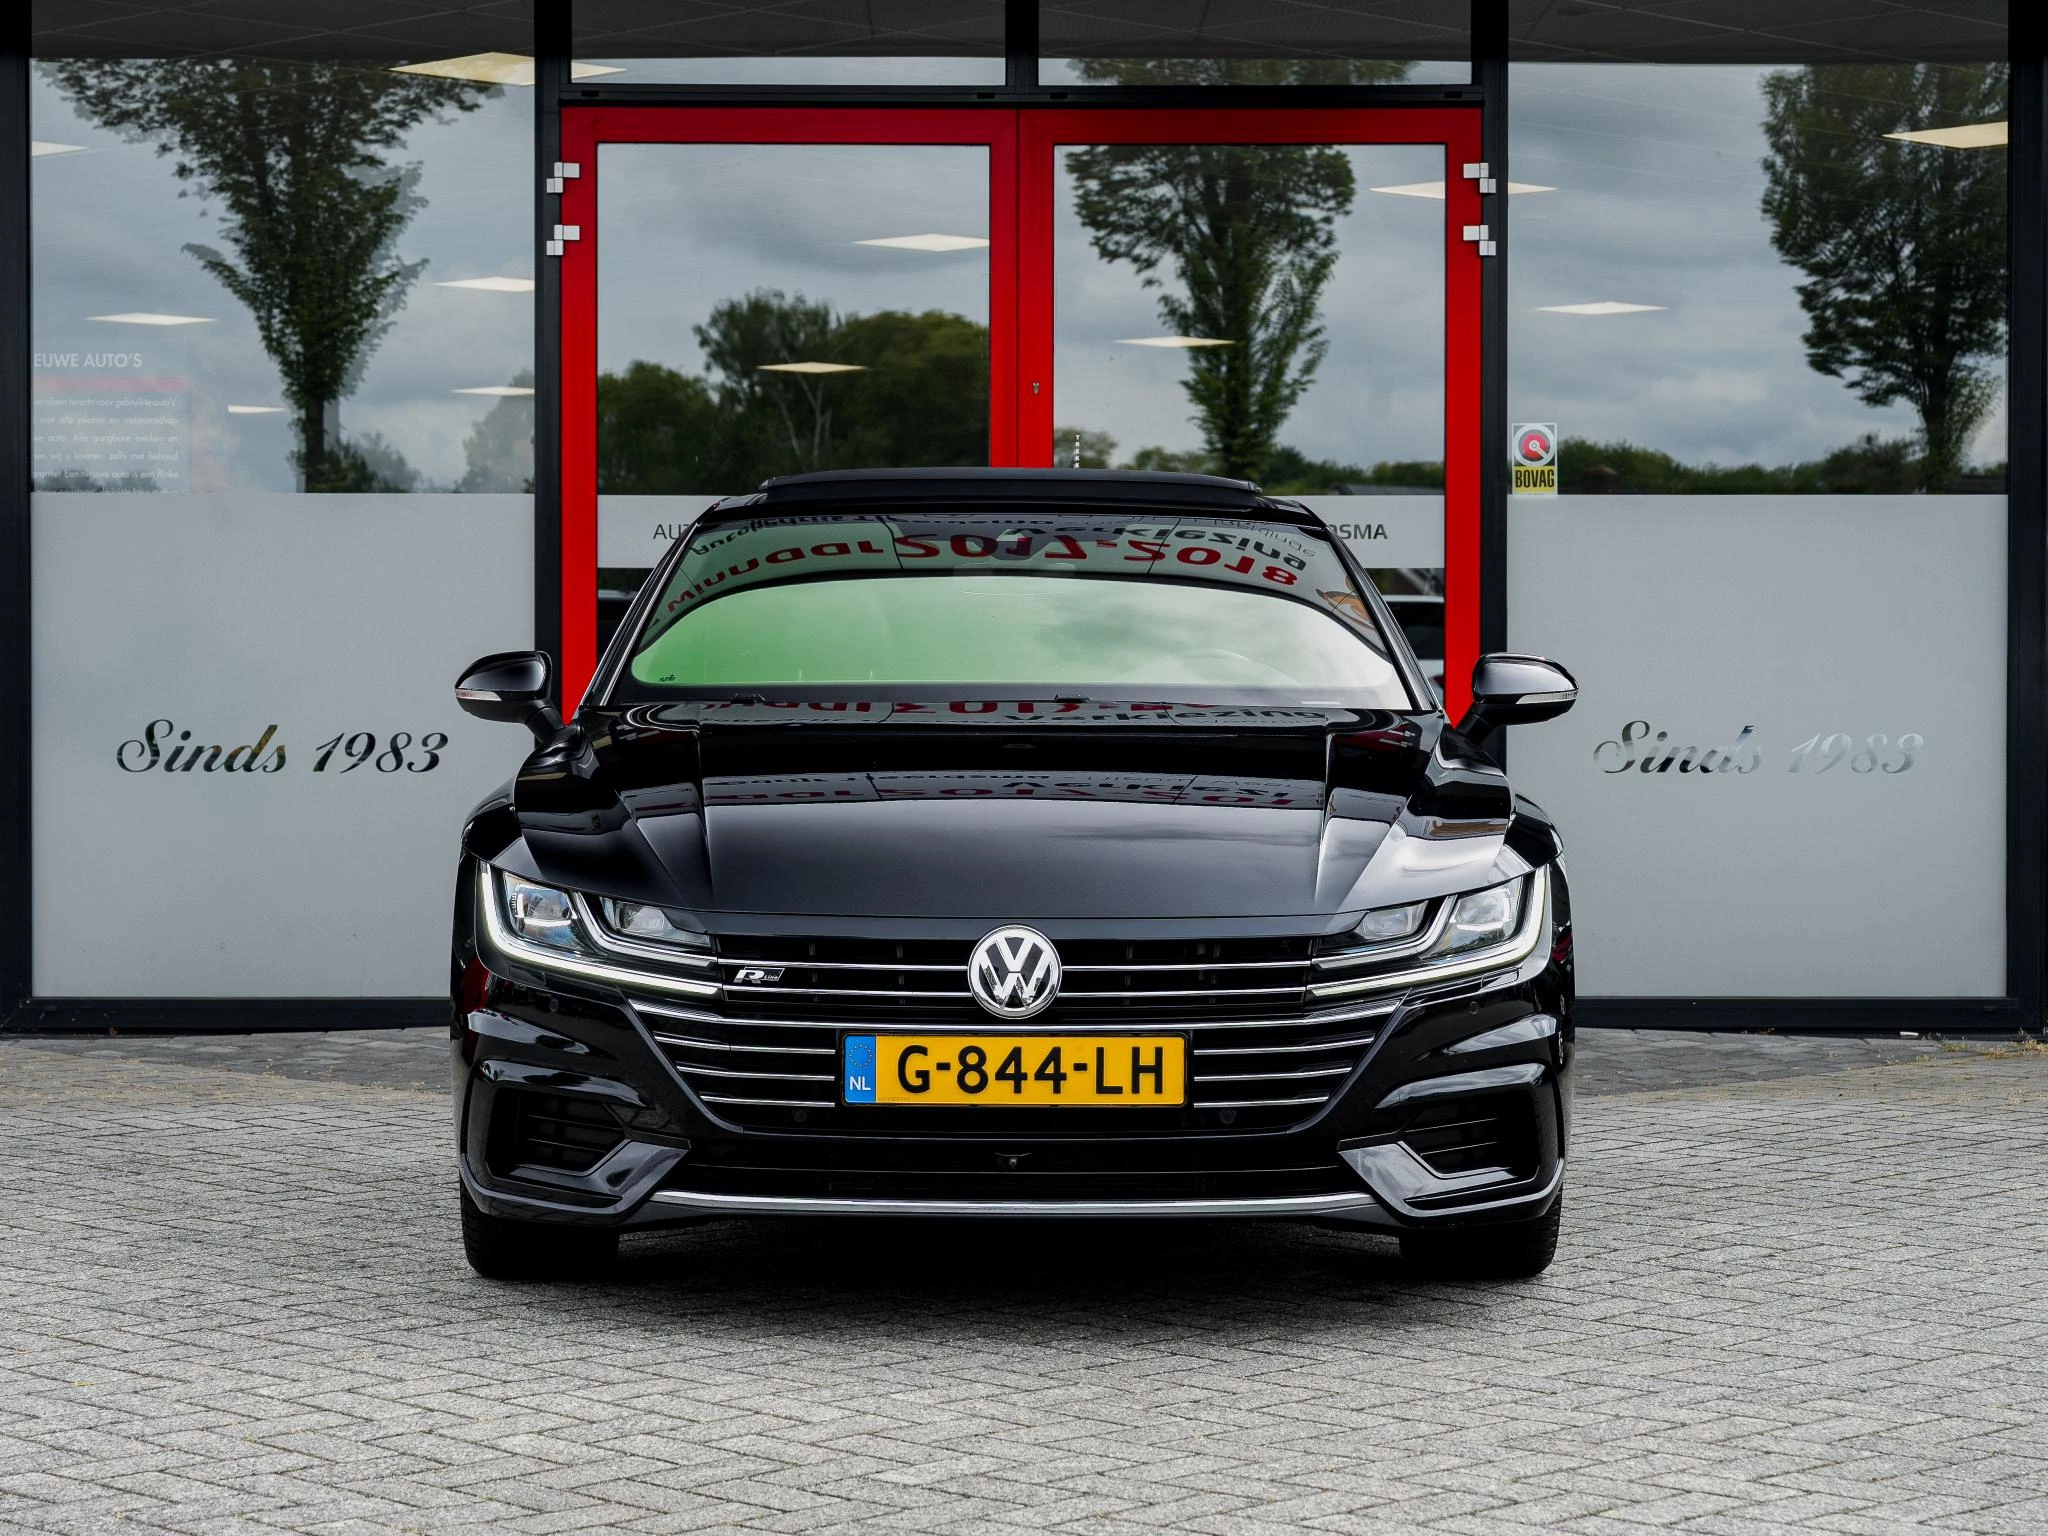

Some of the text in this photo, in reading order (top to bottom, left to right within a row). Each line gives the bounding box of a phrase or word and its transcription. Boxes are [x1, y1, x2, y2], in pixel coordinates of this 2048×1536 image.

[83, 352, 142, 368] AUTO'S
[1515, 469, 1555, 488] BOVAG
[116, 719, 449, 774] Sinds 1983
[1593, 720, 1924, 775] Sinds 1983
[849, 1045, 1164, 1096] NL G-844-LH
